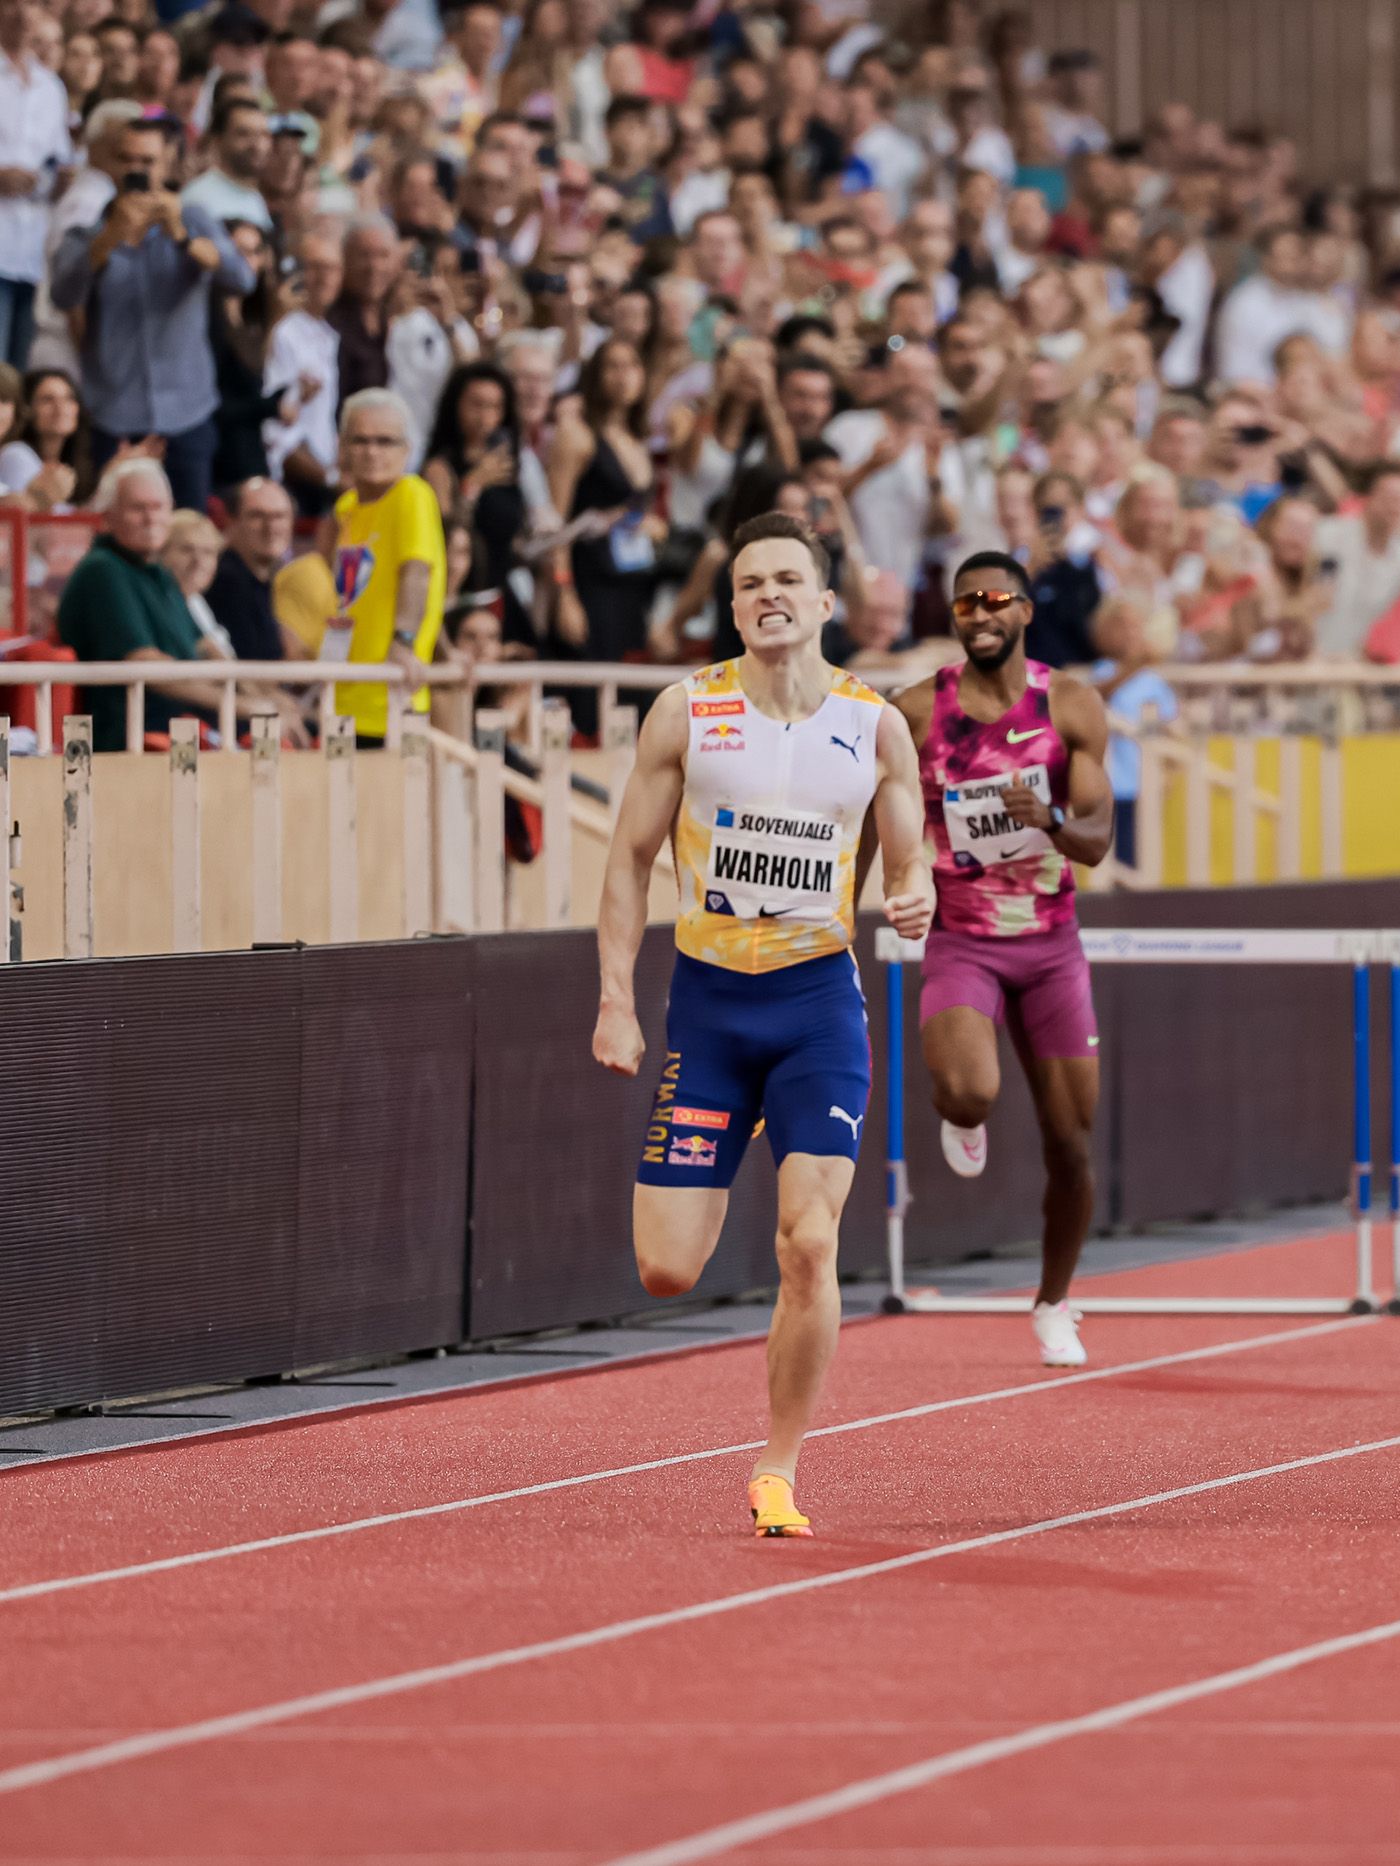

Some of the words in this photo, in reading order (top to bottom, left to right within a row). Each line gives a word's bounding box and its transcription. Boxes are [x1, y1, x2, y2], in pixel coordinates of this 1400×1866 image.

[739, 813, 835, 841] SLOVENIJALES
[714, 846, 833, 893] WARHOLM
[642, 1051, 681, 1164] NORWAY
